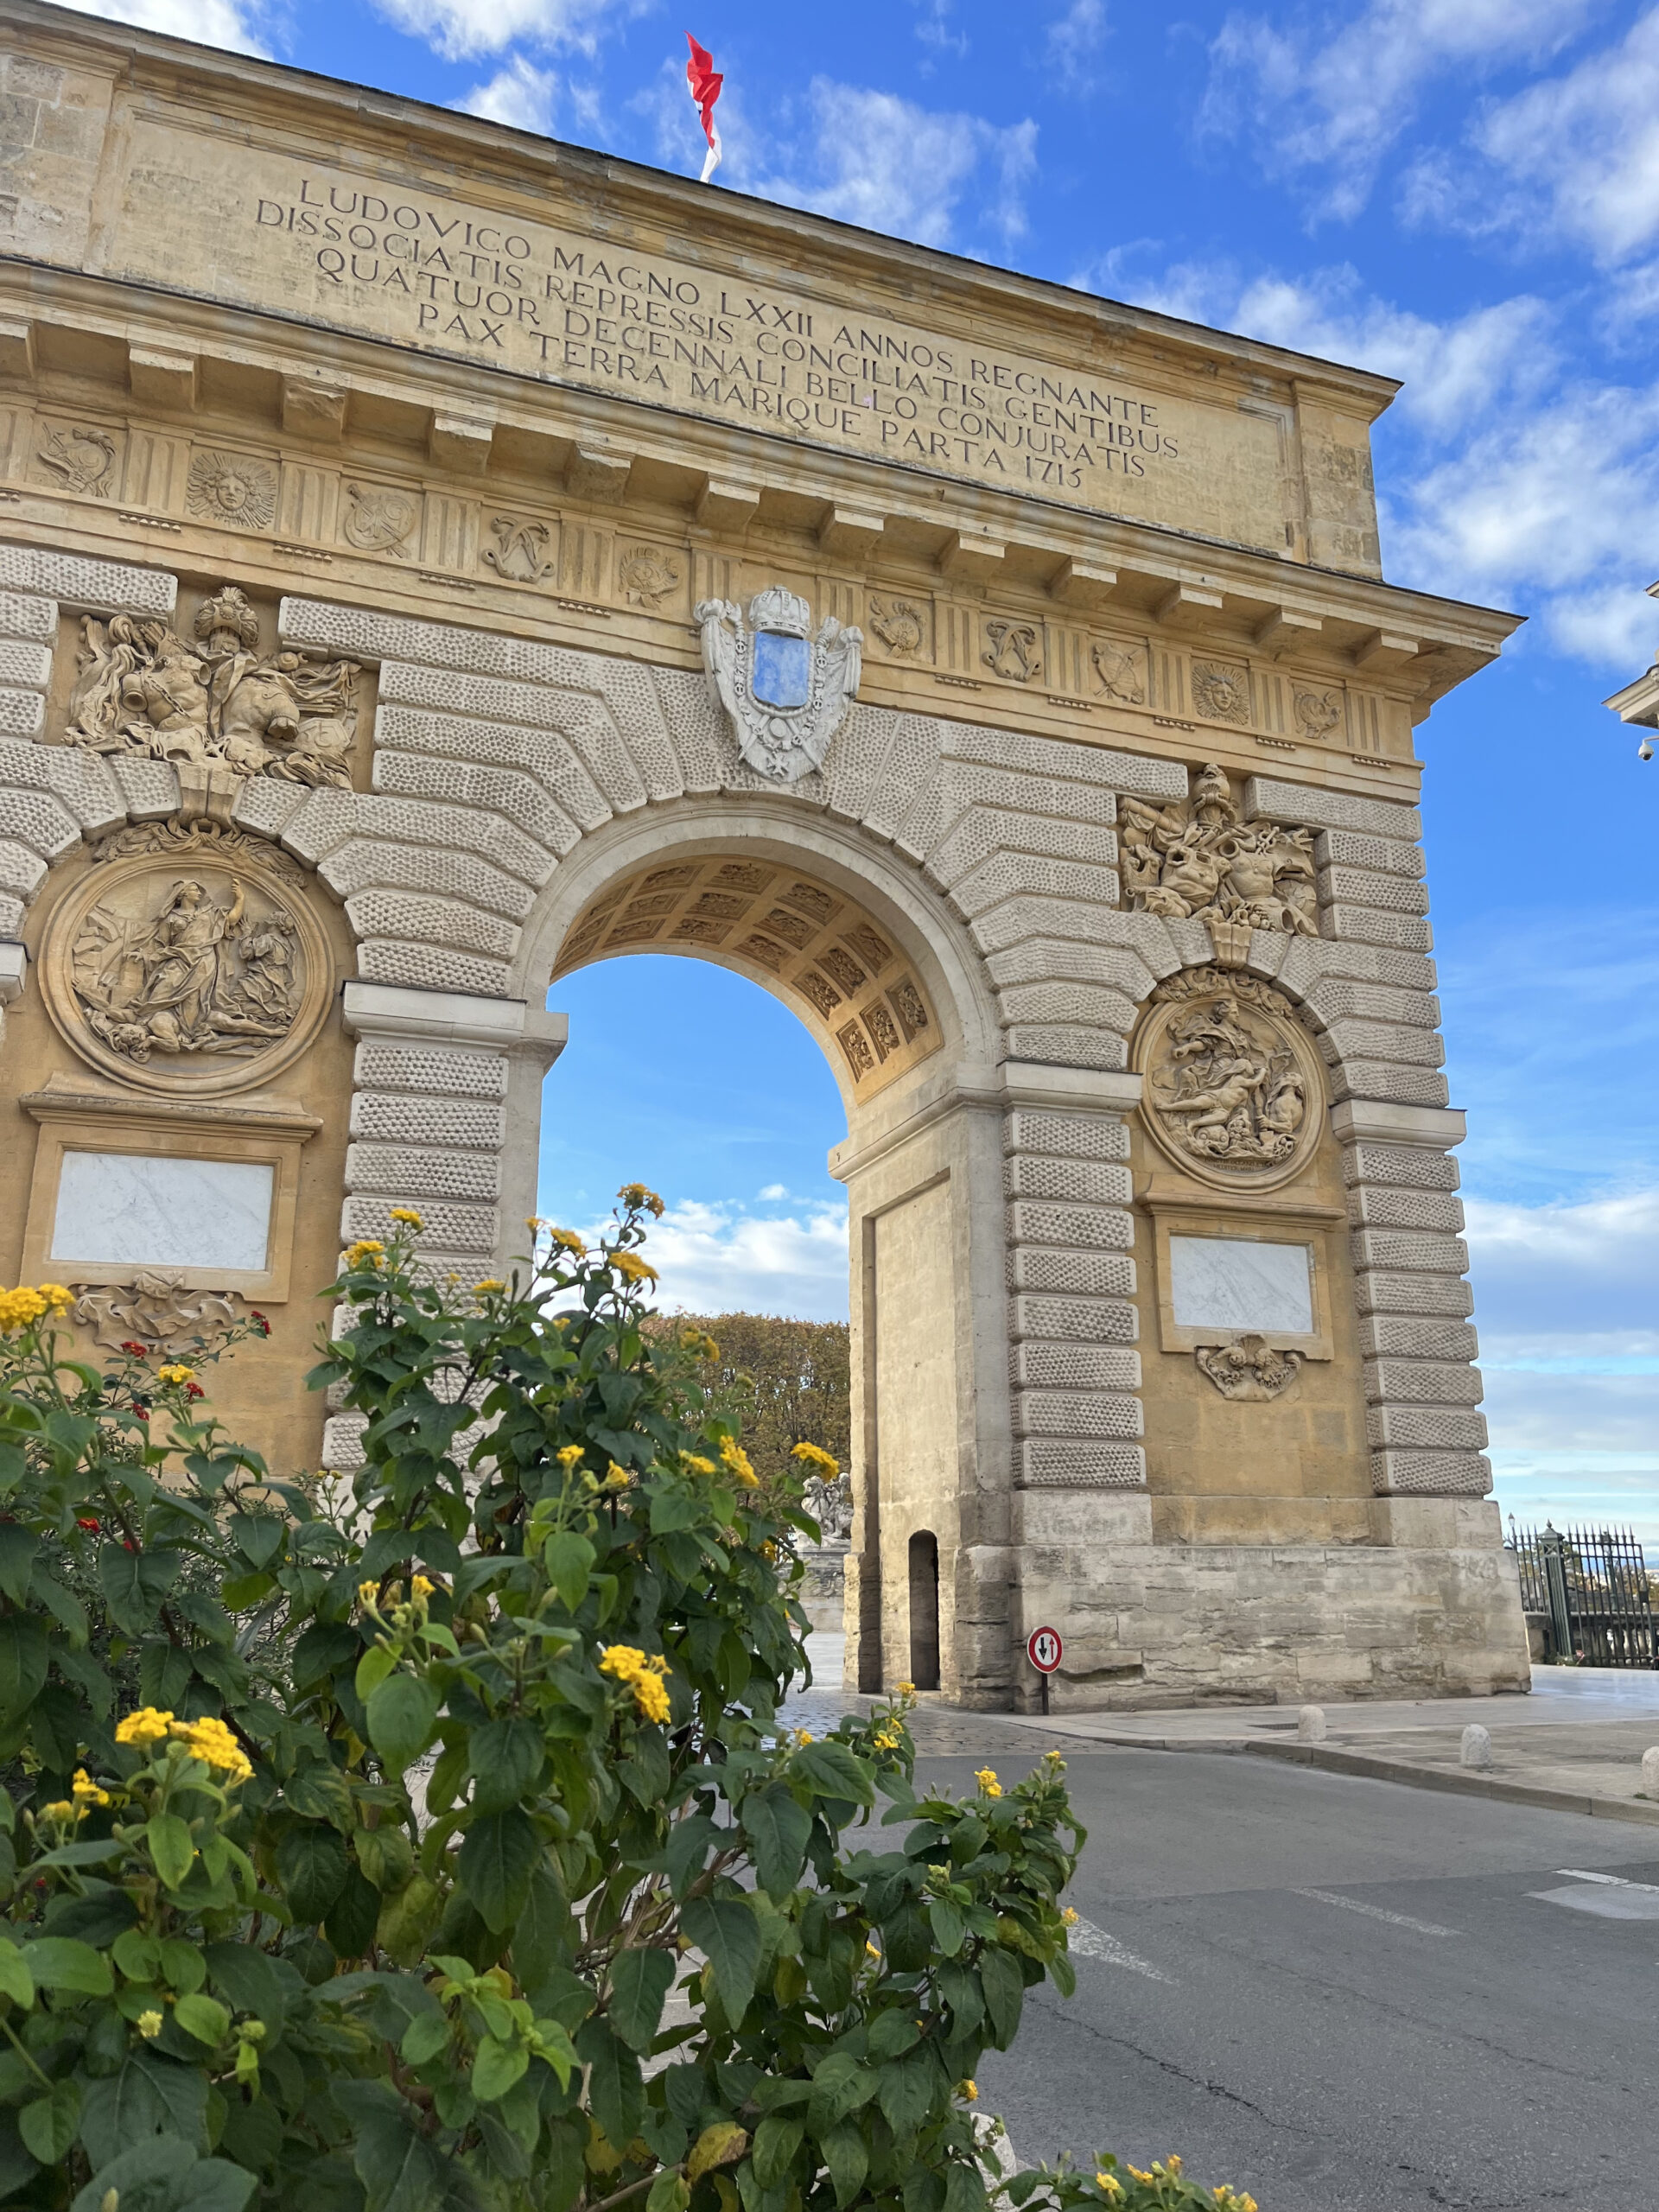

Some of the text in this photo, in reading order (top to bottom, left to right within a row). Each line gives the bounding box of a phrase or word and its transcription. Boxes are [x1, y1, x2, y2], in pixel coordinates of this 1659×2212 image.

[257, 199, 1179, 458] DISSOCIATIS REPRESSIS CONCILIATIS GENTIBUS
[300, 179, 1159, 428] LUDOVICO MAGNO LXXII ANNOS REGNANTE
[316, 248, 1146, 477] QUATUOR DECENNALI BELLO CONJURATIS
[418, 302, 1084, 488] PAX TERRA MARIQUE PARTA 1715
